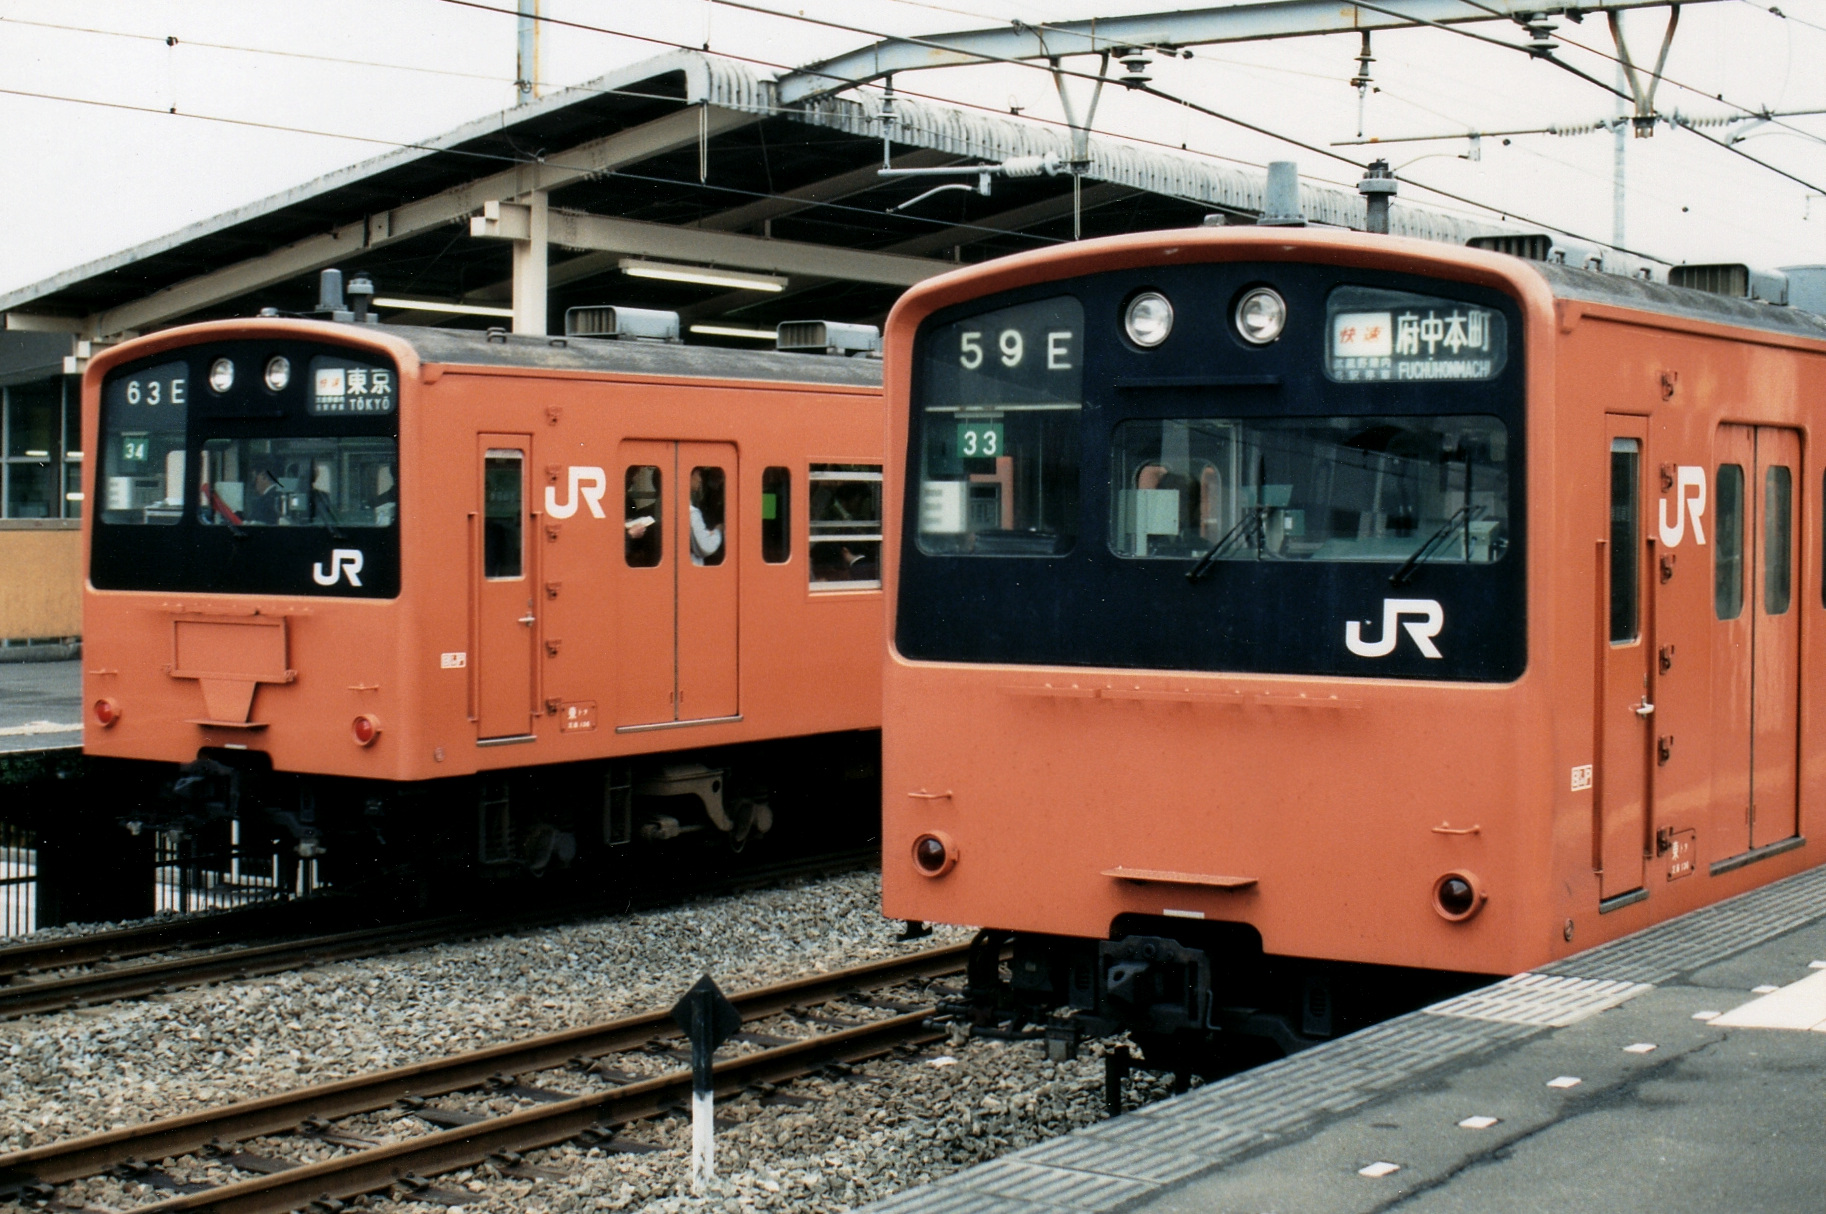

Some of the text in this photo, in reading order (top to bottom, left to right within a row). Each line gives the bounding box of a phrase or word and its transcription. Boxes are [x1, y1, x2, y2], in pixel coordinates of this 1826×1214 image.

[1395, 308, 1492, 355] 府中本町
[346, 367, 392, 395] 東京
[125, 443, 145, 460] 34
[963, 431, 997, 455] 33
[544, 466, 607, 519] JR
[1659, 466, 1707, 548] JR
[313, 549, 364, 587] JR
[1346, 598, 1444, 659] JR
